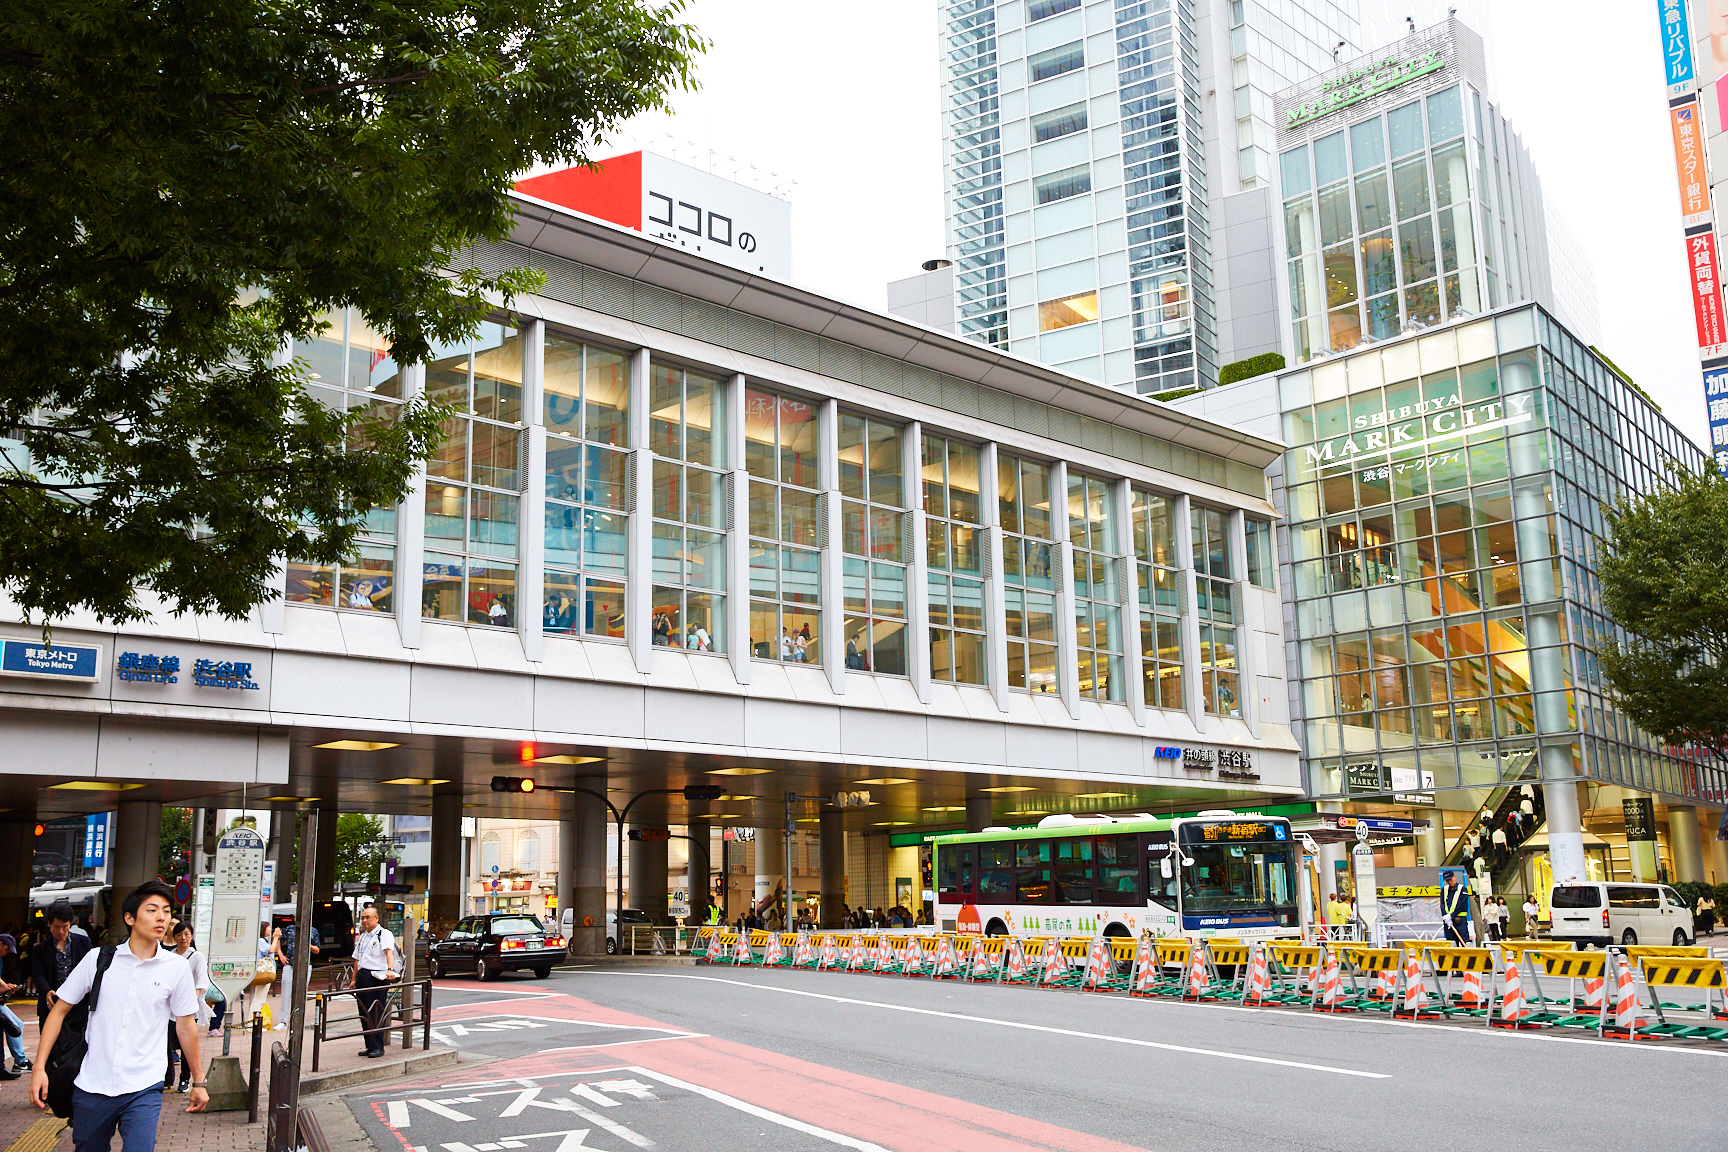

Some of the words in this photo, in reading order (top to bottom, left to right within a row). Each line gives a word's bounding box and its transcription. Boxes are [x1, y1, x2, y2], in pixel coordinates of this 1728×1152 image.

[1321, 55, 1397, 92] SHIBUYA
[1285, 81, 1364, 124] MARK
[1370, 50, 1440, 88] CITY
[1673, 82, 1689, 94] 9F
[1679, 123, 1702, 211] 東京スター銀行
[648, 190, 757, 253] ココロの
[1689, 213, 1705, 224] 8F
[1692, 235, 1715, 297] 外貨両替
[1705, 344, 1722, 356] 7F
[1354, 393, 1461, 430] SHIBUYA
[1303, 422, 1415, 466] MARK
[1432, 393, 1531, 434] CITY
[1362, 466, 1390, 483] 渋谷
[1394, 451, 1460, 475] マークシティ
[24, 647, 78, 663] 東京メトロ
[27, 658, 51, 669] Tokyo
[50, 661, 74, 671] Metro
[118, 651, 181, 673] 銀座線
[193, 658, 253, 680] 渋谷駅
[118, 669, 152, 683] Ginza
[153, 673, 178, 685] Line
[194, 674, 240, 690] Shibuya
[1154, 746, 1182, 759] KEIO
[1219, 749, 1252, 769] 渋谷駅
[1349, 776, 1372, 786] MARK
[85, 824, 94, 857] 横浜銀行
[95, 824, 105, 857] 横浜銀行
[1356, 825, 1367, 837] 40
[673, 891, 684, 902] 40
[1044, 917, 1072, 932] 高尾の森
[1200, 918, 1216, 926] KEIO
